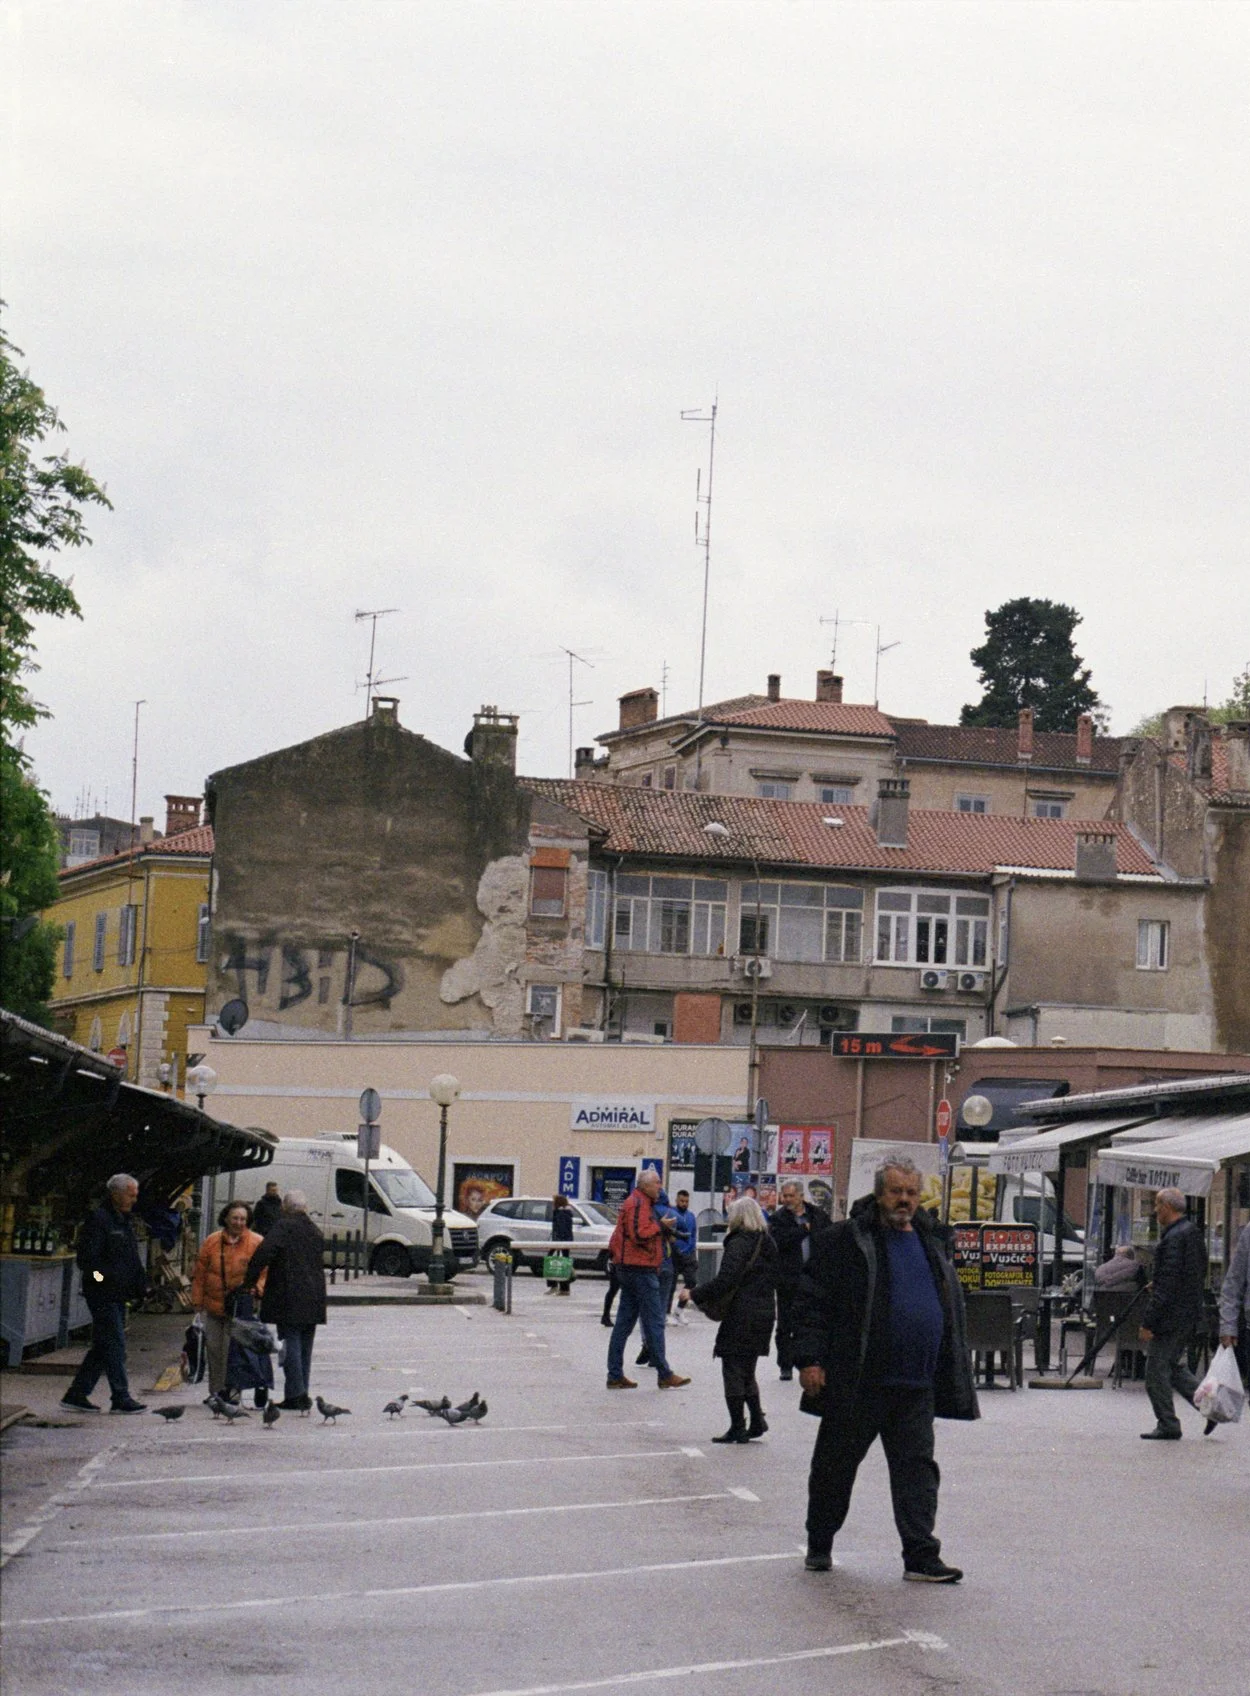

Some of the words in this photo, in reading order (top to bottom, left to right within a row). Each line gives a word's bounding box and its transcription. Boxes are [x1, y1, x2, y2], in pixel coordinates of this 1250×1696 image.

[841, 1039, 861, 1053] 15
[865, 1042, 882, 1053] m
[576, 1110, 650, 1124] ADMIRAL
[983, 1230, 1035, 1243] FOTO
